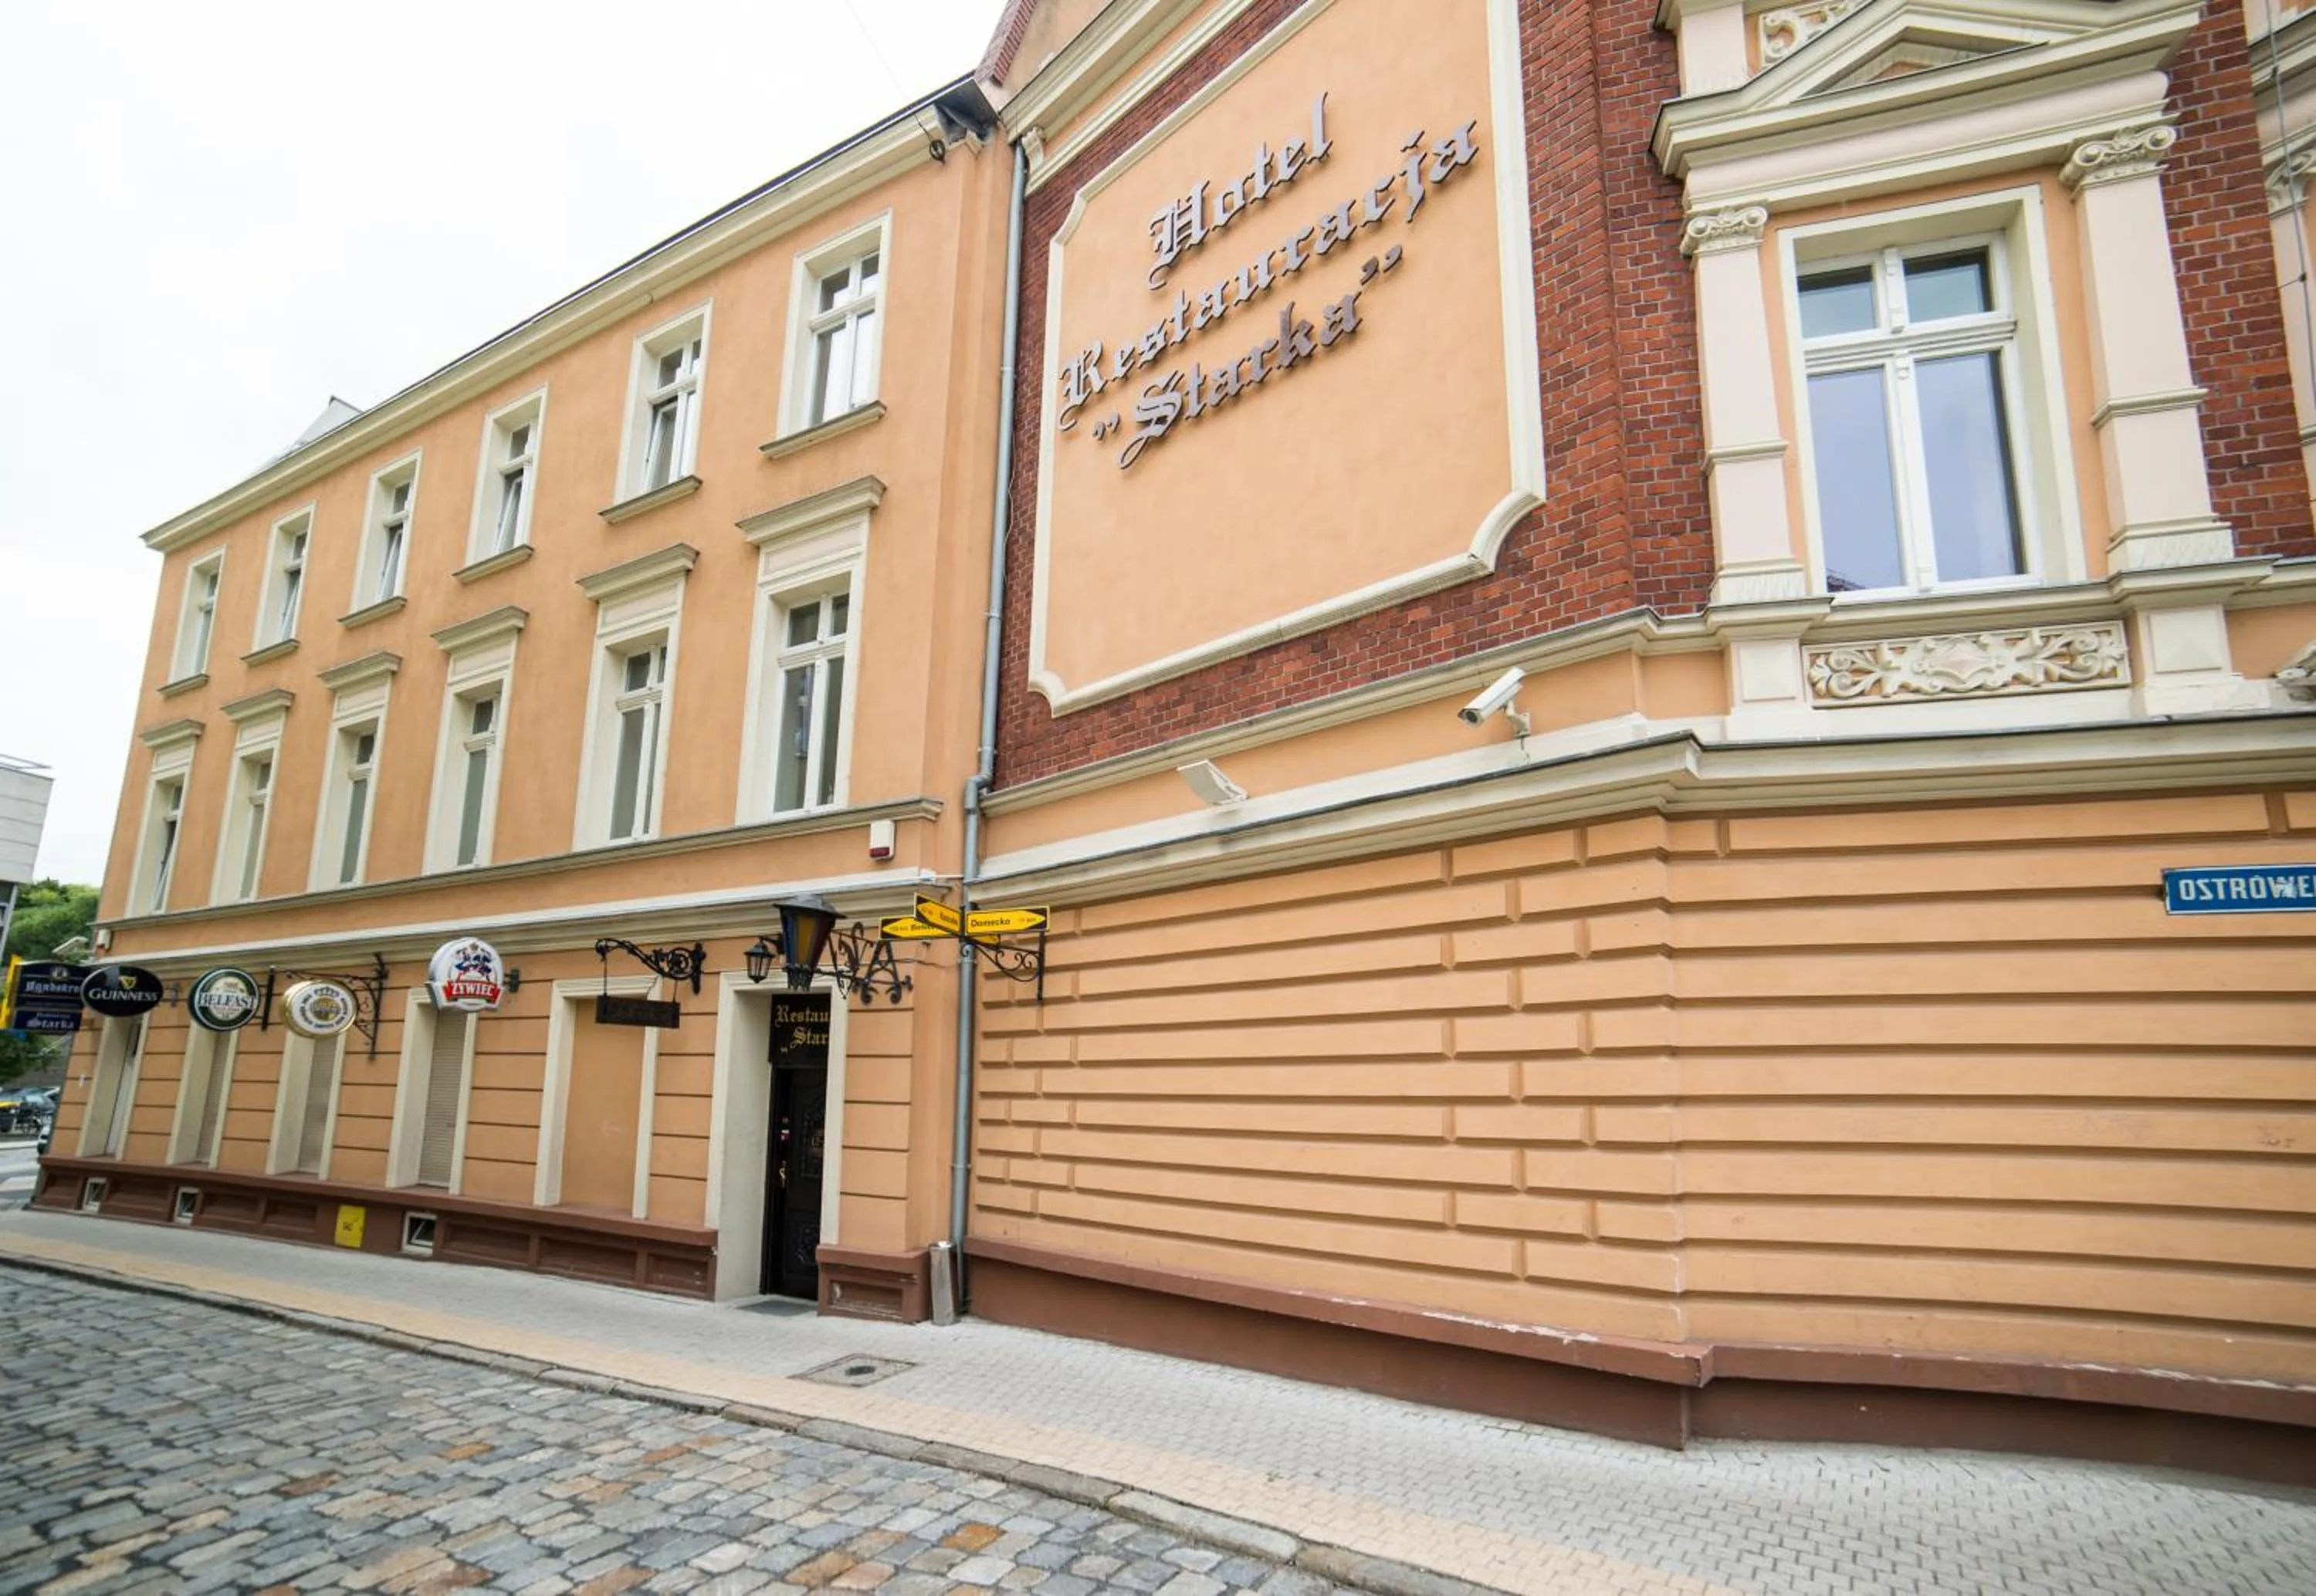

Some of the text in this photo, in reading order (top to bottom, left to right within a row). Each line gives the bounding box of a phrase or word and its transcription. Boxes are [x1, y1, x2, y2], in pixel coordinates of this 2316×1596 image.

[1148, 92, 1333, 291] Hotel
[1058, 120, 1480, 432] Restauracja
[88, 987, 159, 1002] GUINNESS
[774, 1004, 830, 1028] Restau
